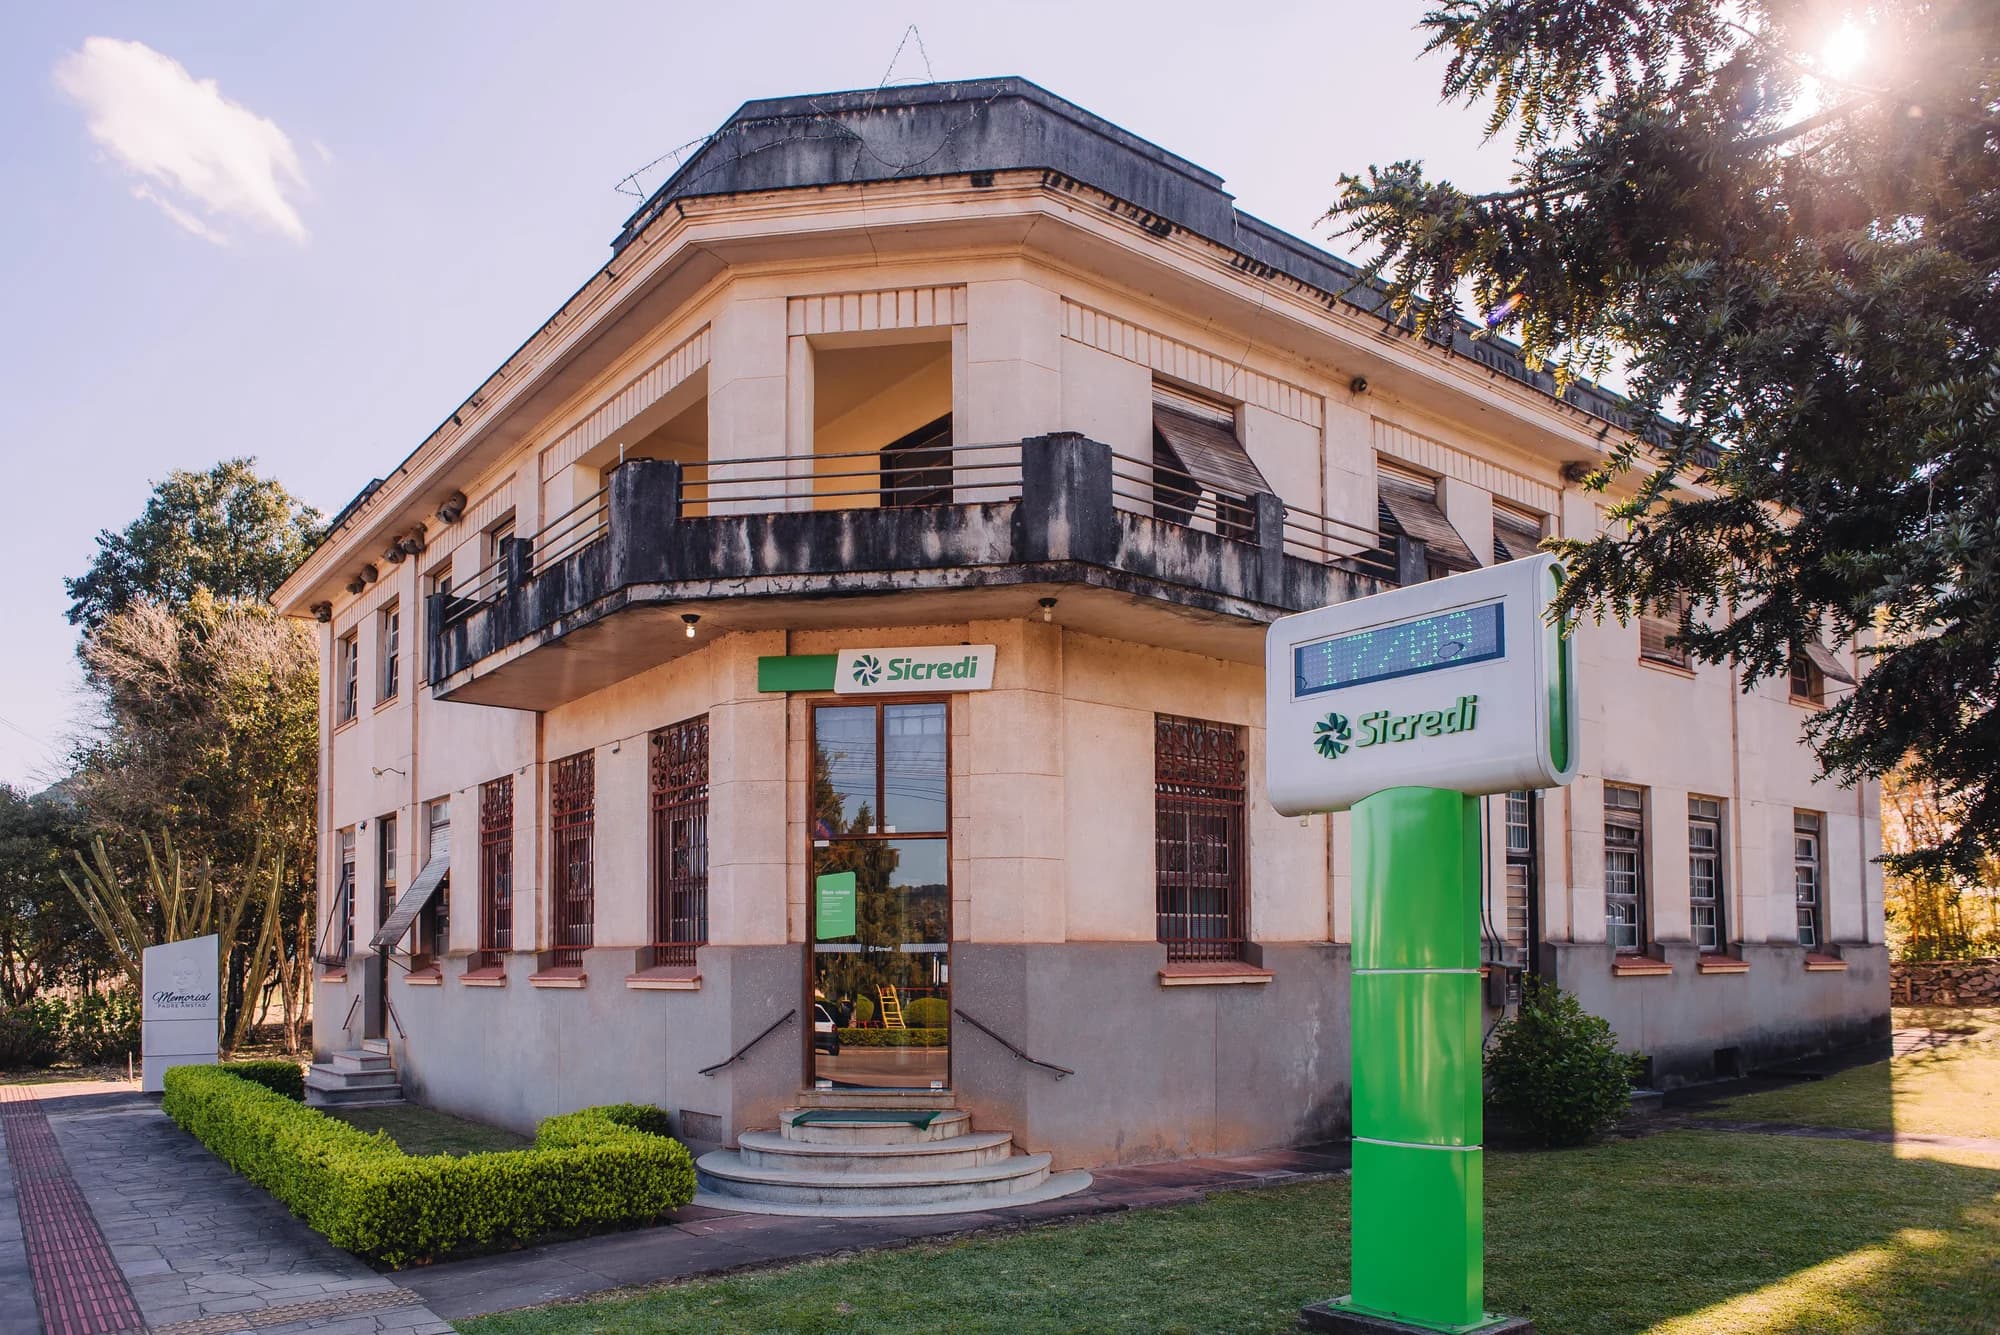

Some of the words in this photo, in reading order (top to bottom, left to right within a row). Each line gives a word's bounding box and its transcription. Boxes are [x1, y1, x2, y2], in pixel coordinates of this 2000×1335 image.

[887, 656, 978, 681] Sicredi
[1355, 695, 1478, 748] Sicredi
[152, 991, 212, 1003] Memorial
